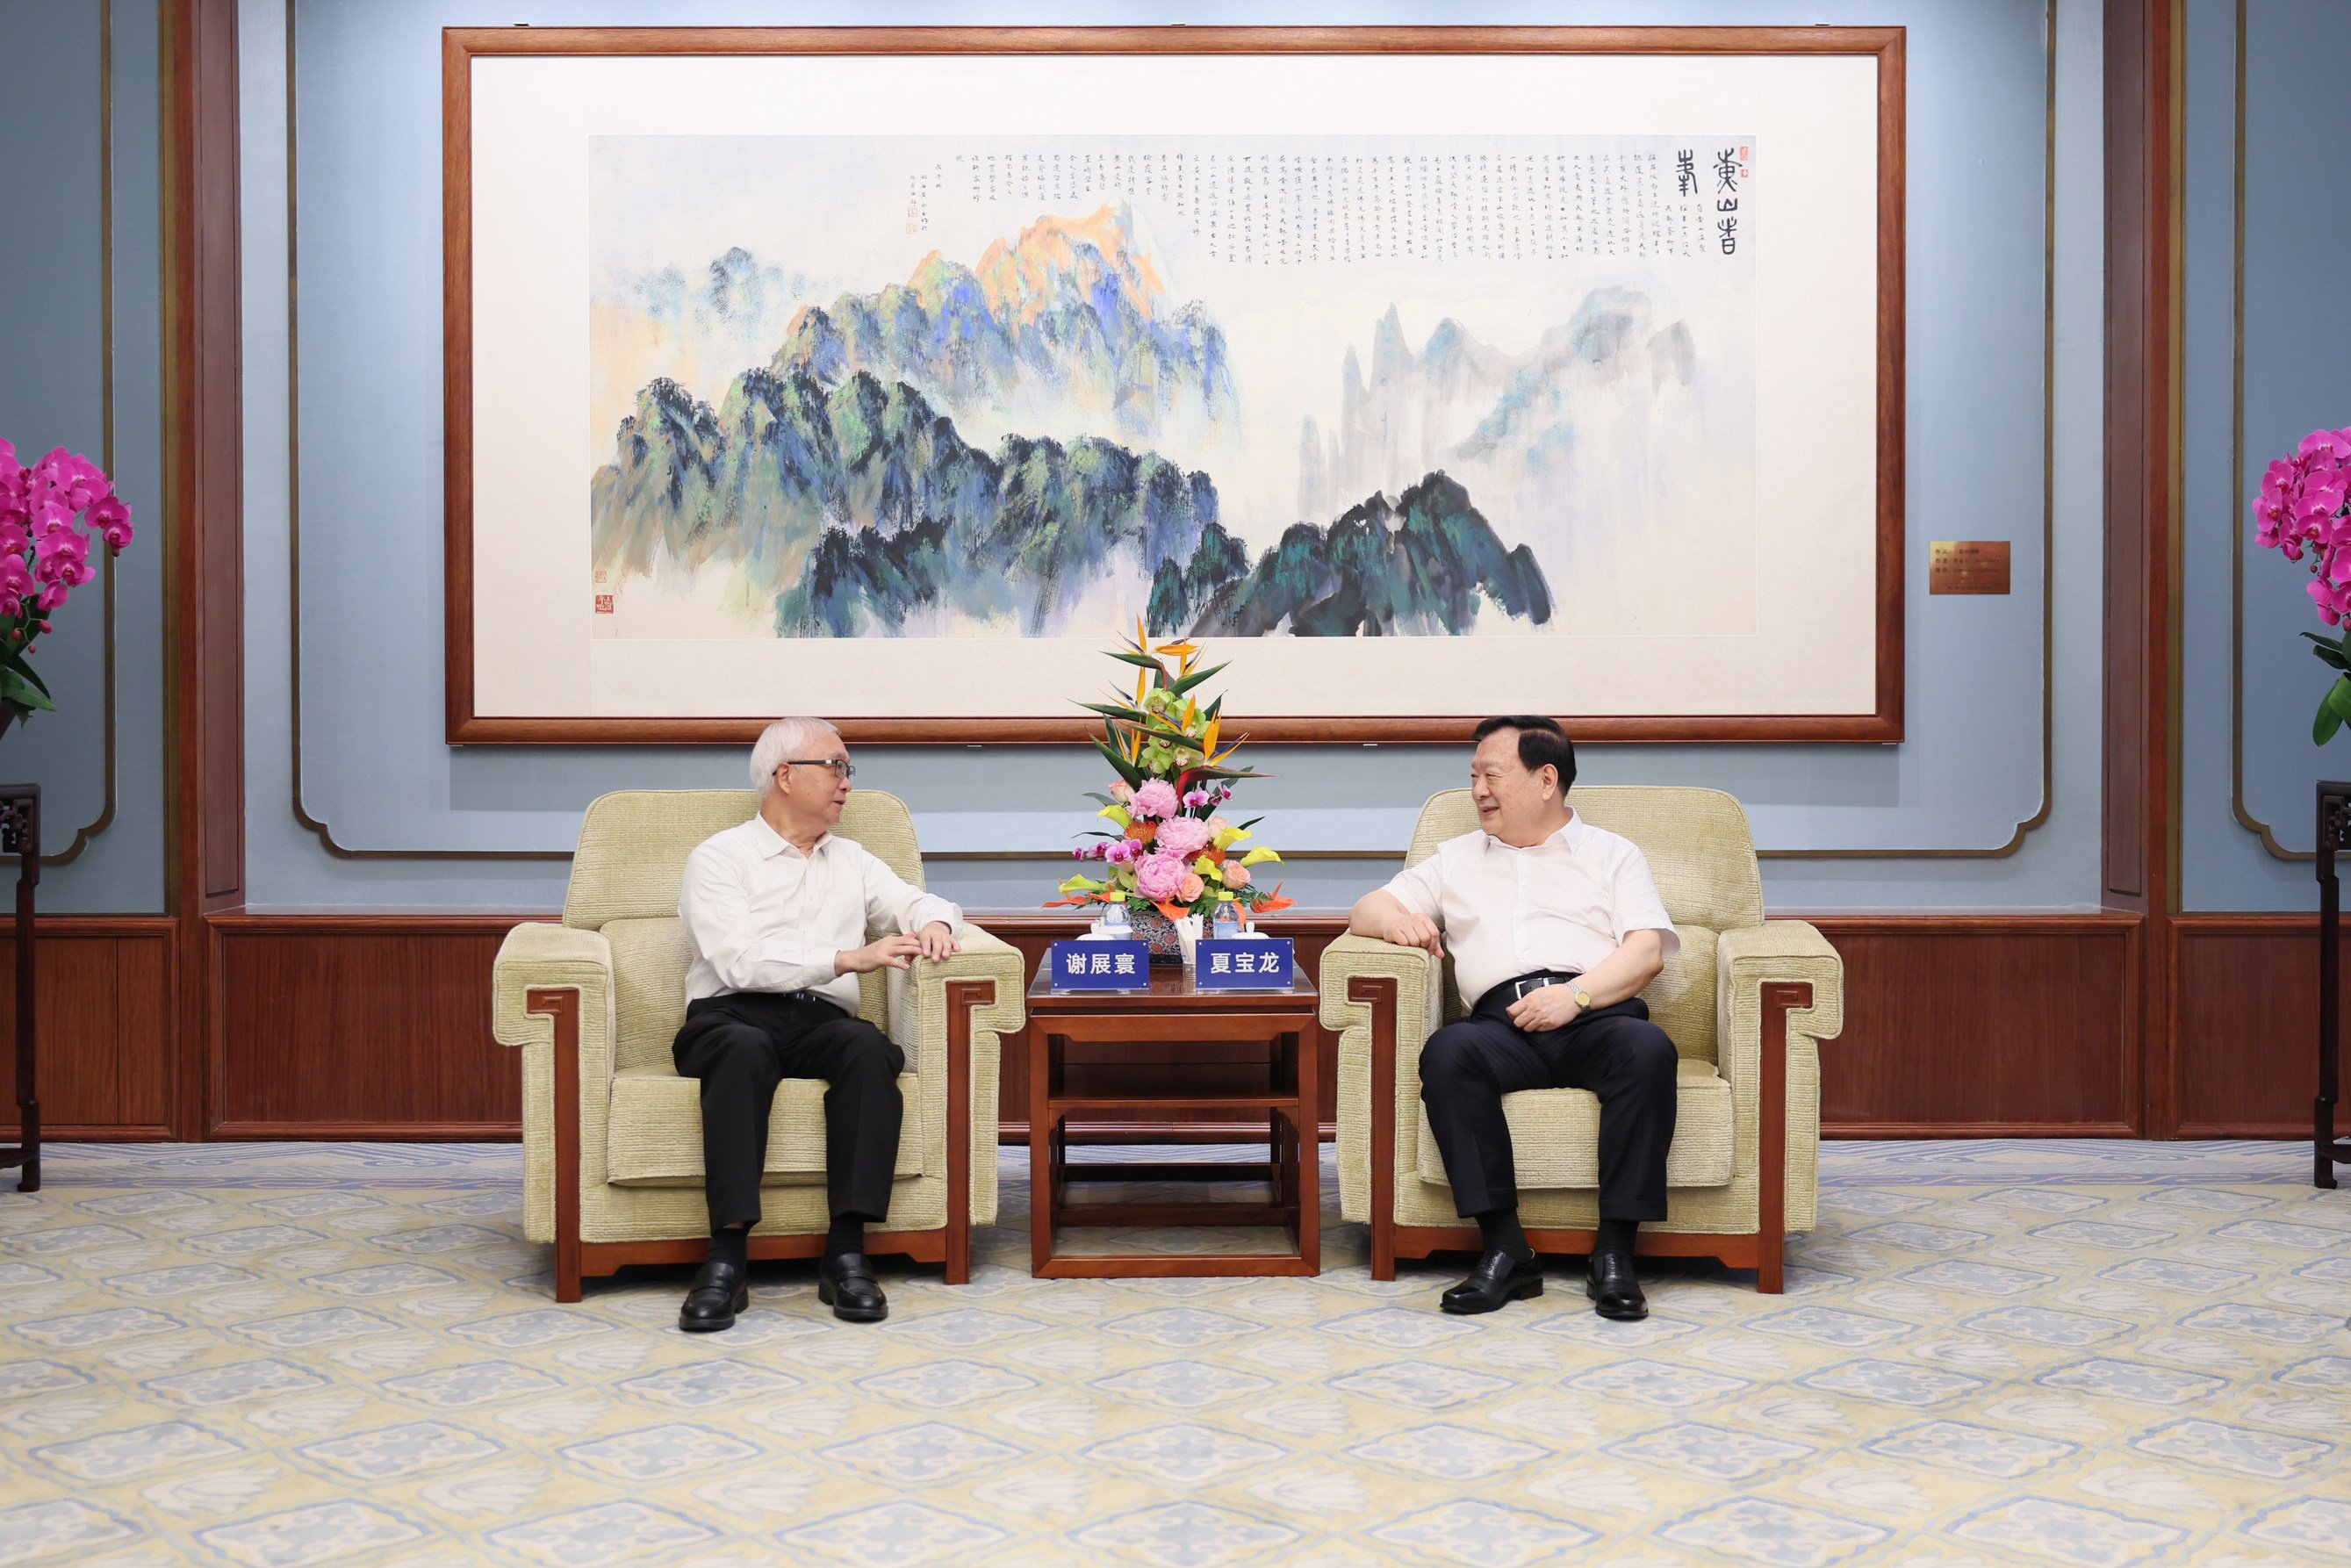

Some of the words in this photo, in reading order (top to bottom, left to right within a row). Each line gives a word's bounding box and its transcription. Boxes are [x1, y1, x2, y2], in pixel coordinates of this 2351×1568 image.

[1066, 953, 1136, 975] 谢展寰
[1210, 952, 1280, 975] 夏宝龙
